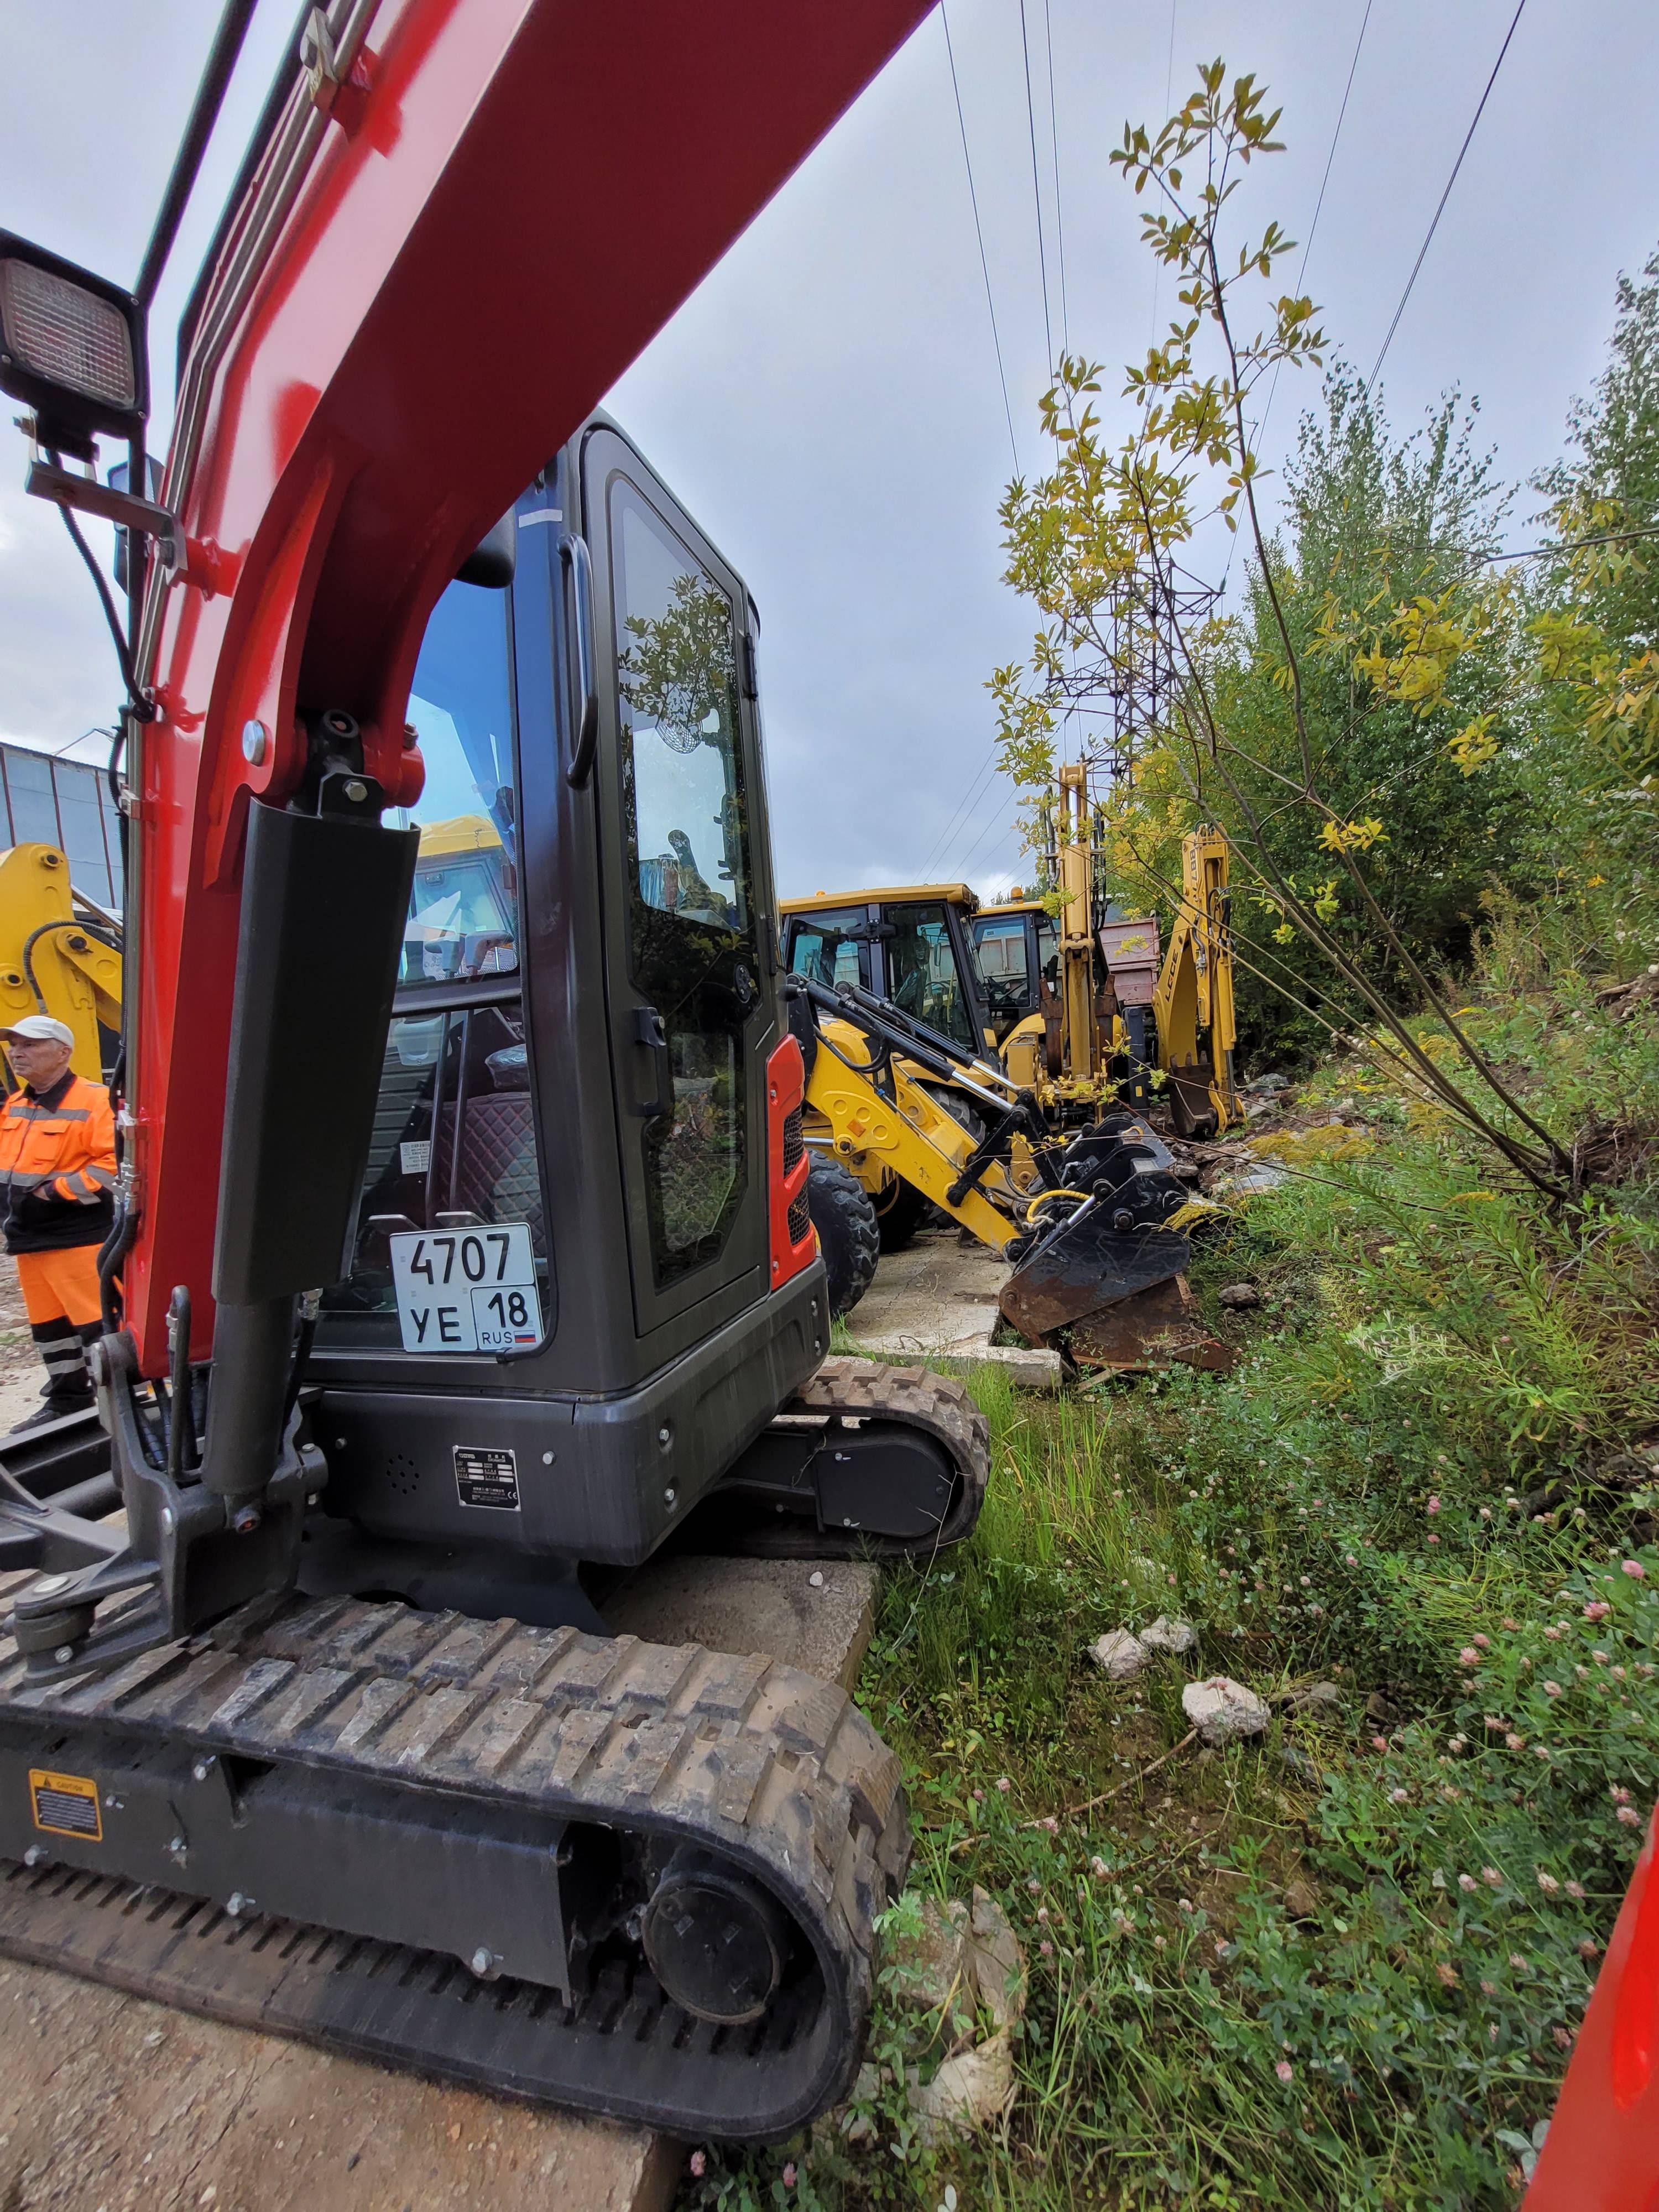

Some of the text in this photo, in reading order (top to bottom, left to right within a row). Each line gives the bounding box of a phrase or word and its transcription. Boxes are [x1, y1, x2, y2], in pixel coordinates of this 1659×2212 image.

[410, 1232, 510, 1285] 4707
[488, 1292, 528, 1328] 18
[482, 1331, 513, 1344] RUS
